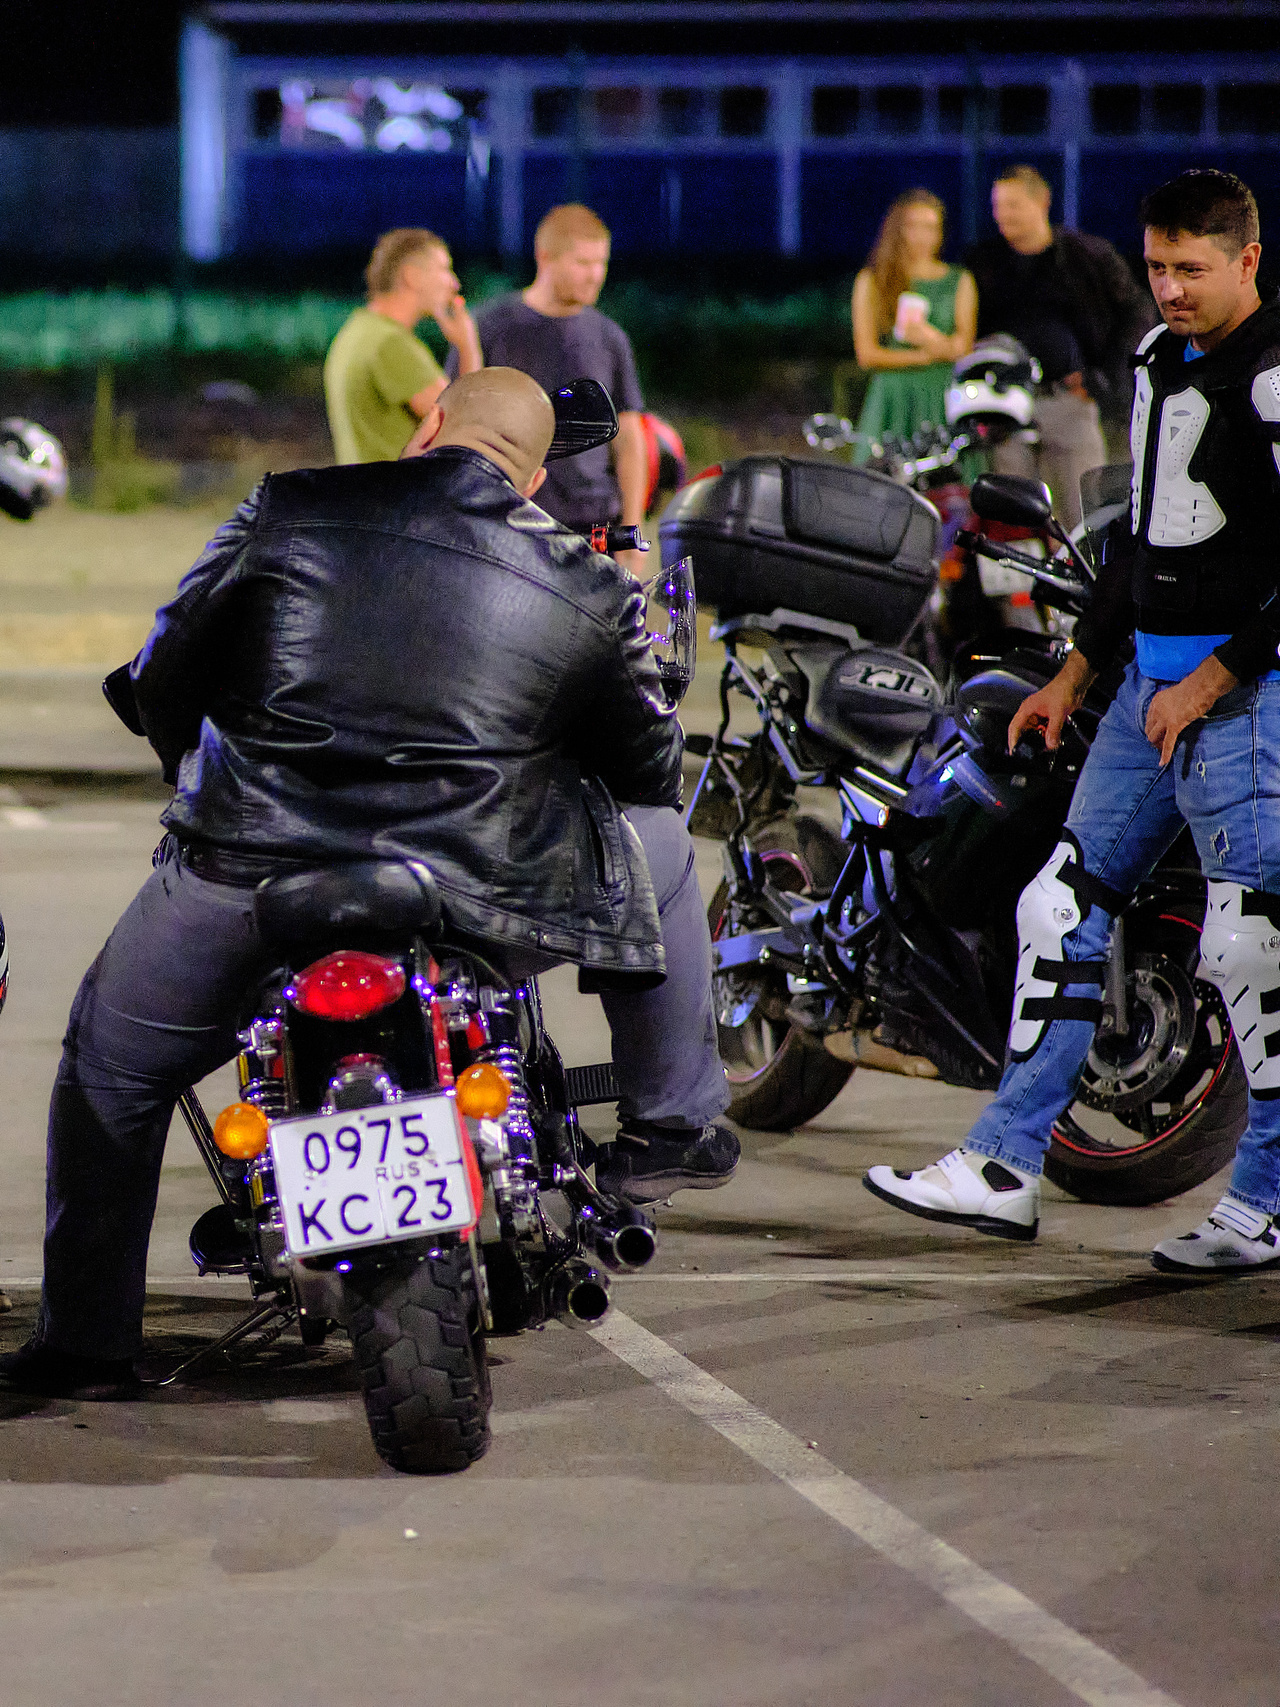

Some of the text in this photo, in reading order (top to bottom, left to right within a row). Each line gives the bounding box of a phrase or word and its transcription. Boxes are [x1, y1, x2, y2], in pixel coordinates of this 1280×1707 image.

[303, 1113, 429, 1175] 0975
[375, 1161, 421, 1181] RUS
[392, 1177, 452, 1229] 23
